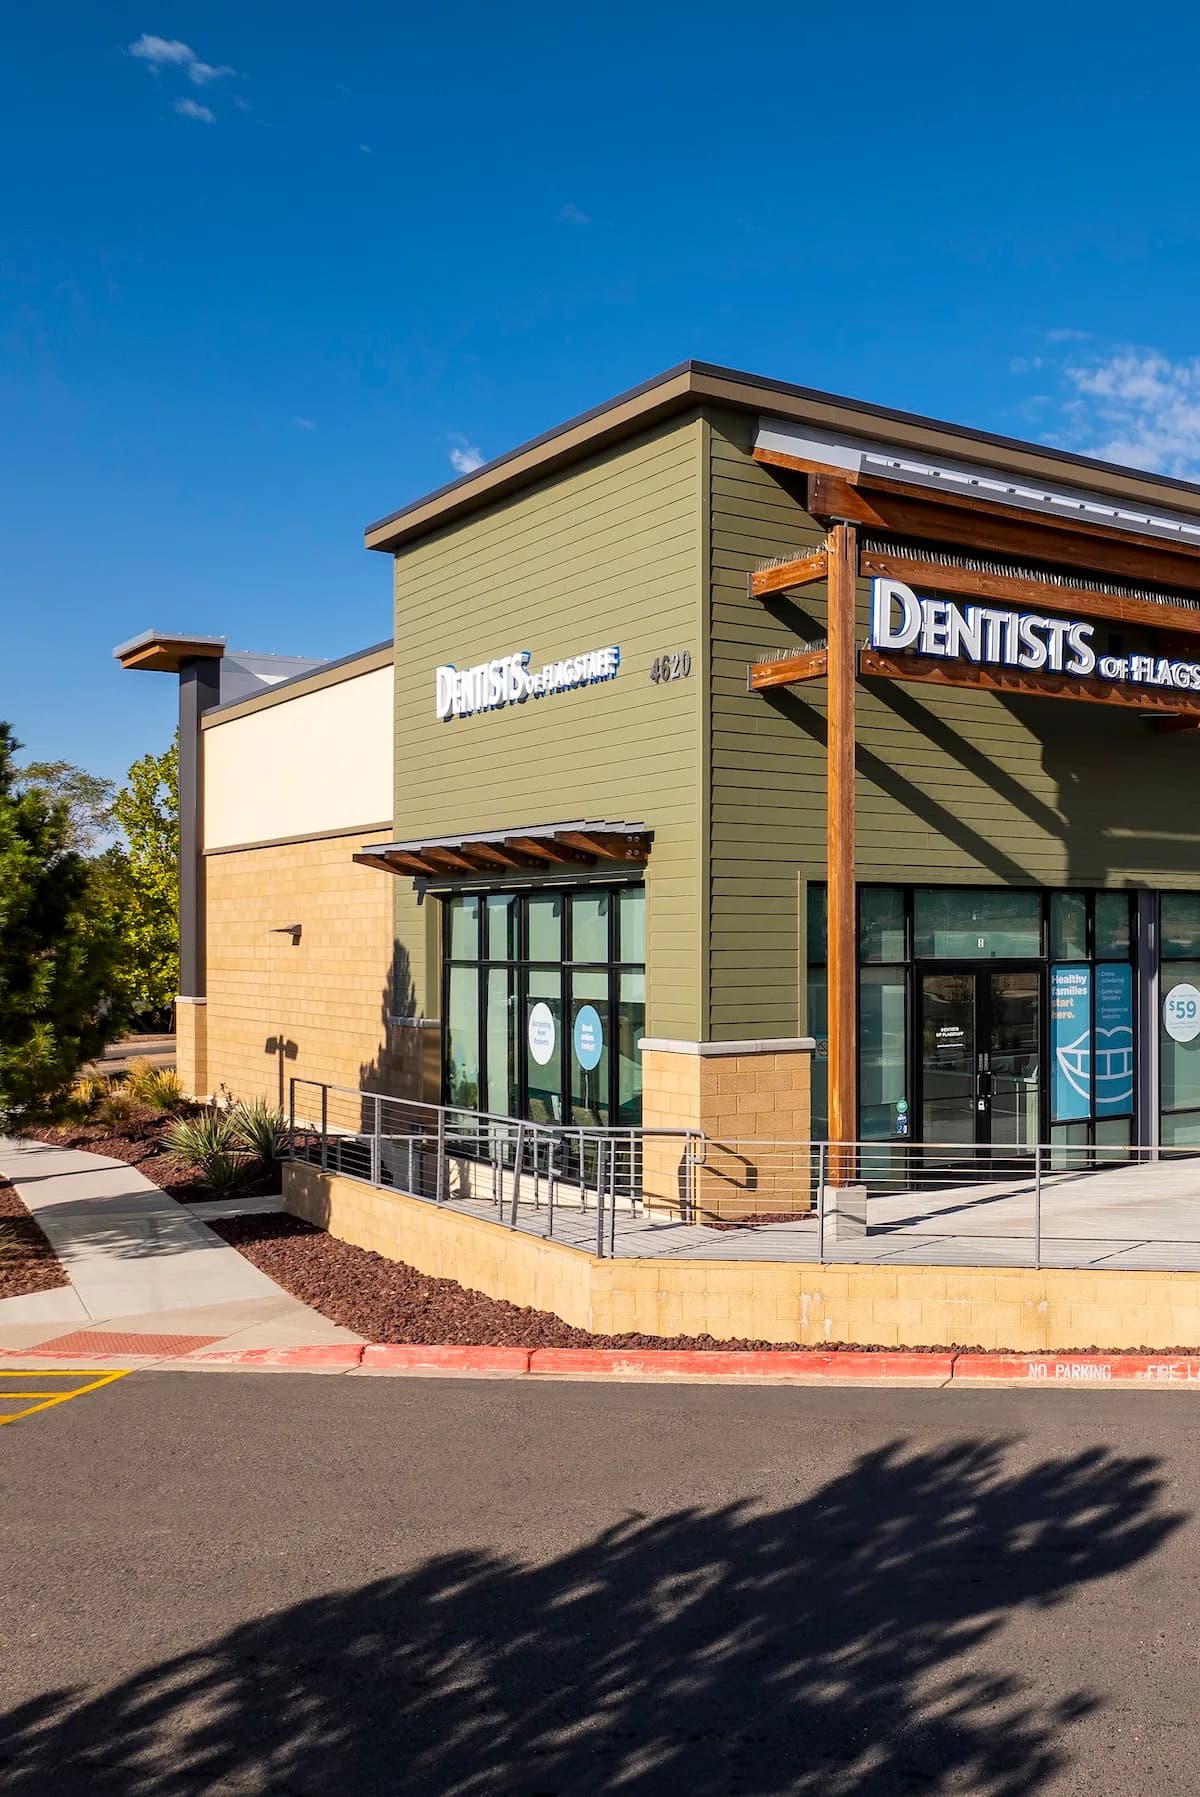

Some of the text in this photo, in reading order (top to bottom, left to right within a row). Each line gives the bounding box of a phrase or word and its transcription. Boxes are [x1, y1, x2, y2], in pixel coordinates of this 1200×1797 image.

[873, 577, 1097, 676] DENTISTS
[1099, 656, 1130, 680] OF
[650, 649, 692, 685] 4620
[436, 651, 531, 719] DENTISTS
[543, 646, 620, 692] FLAGSTAFF
[1051, 974, 1087, 985] Healthy
[1051, 986, 1088, 996] families
[1051, 998, 1075, 1007] start
[1168, 1000, 1197, 1019] $59
[1051, 1010, 1075, 1019] here.
[1029, 1363, 1048, 1379] NO
[1055, 1363, 1112, 1380] PARKING
